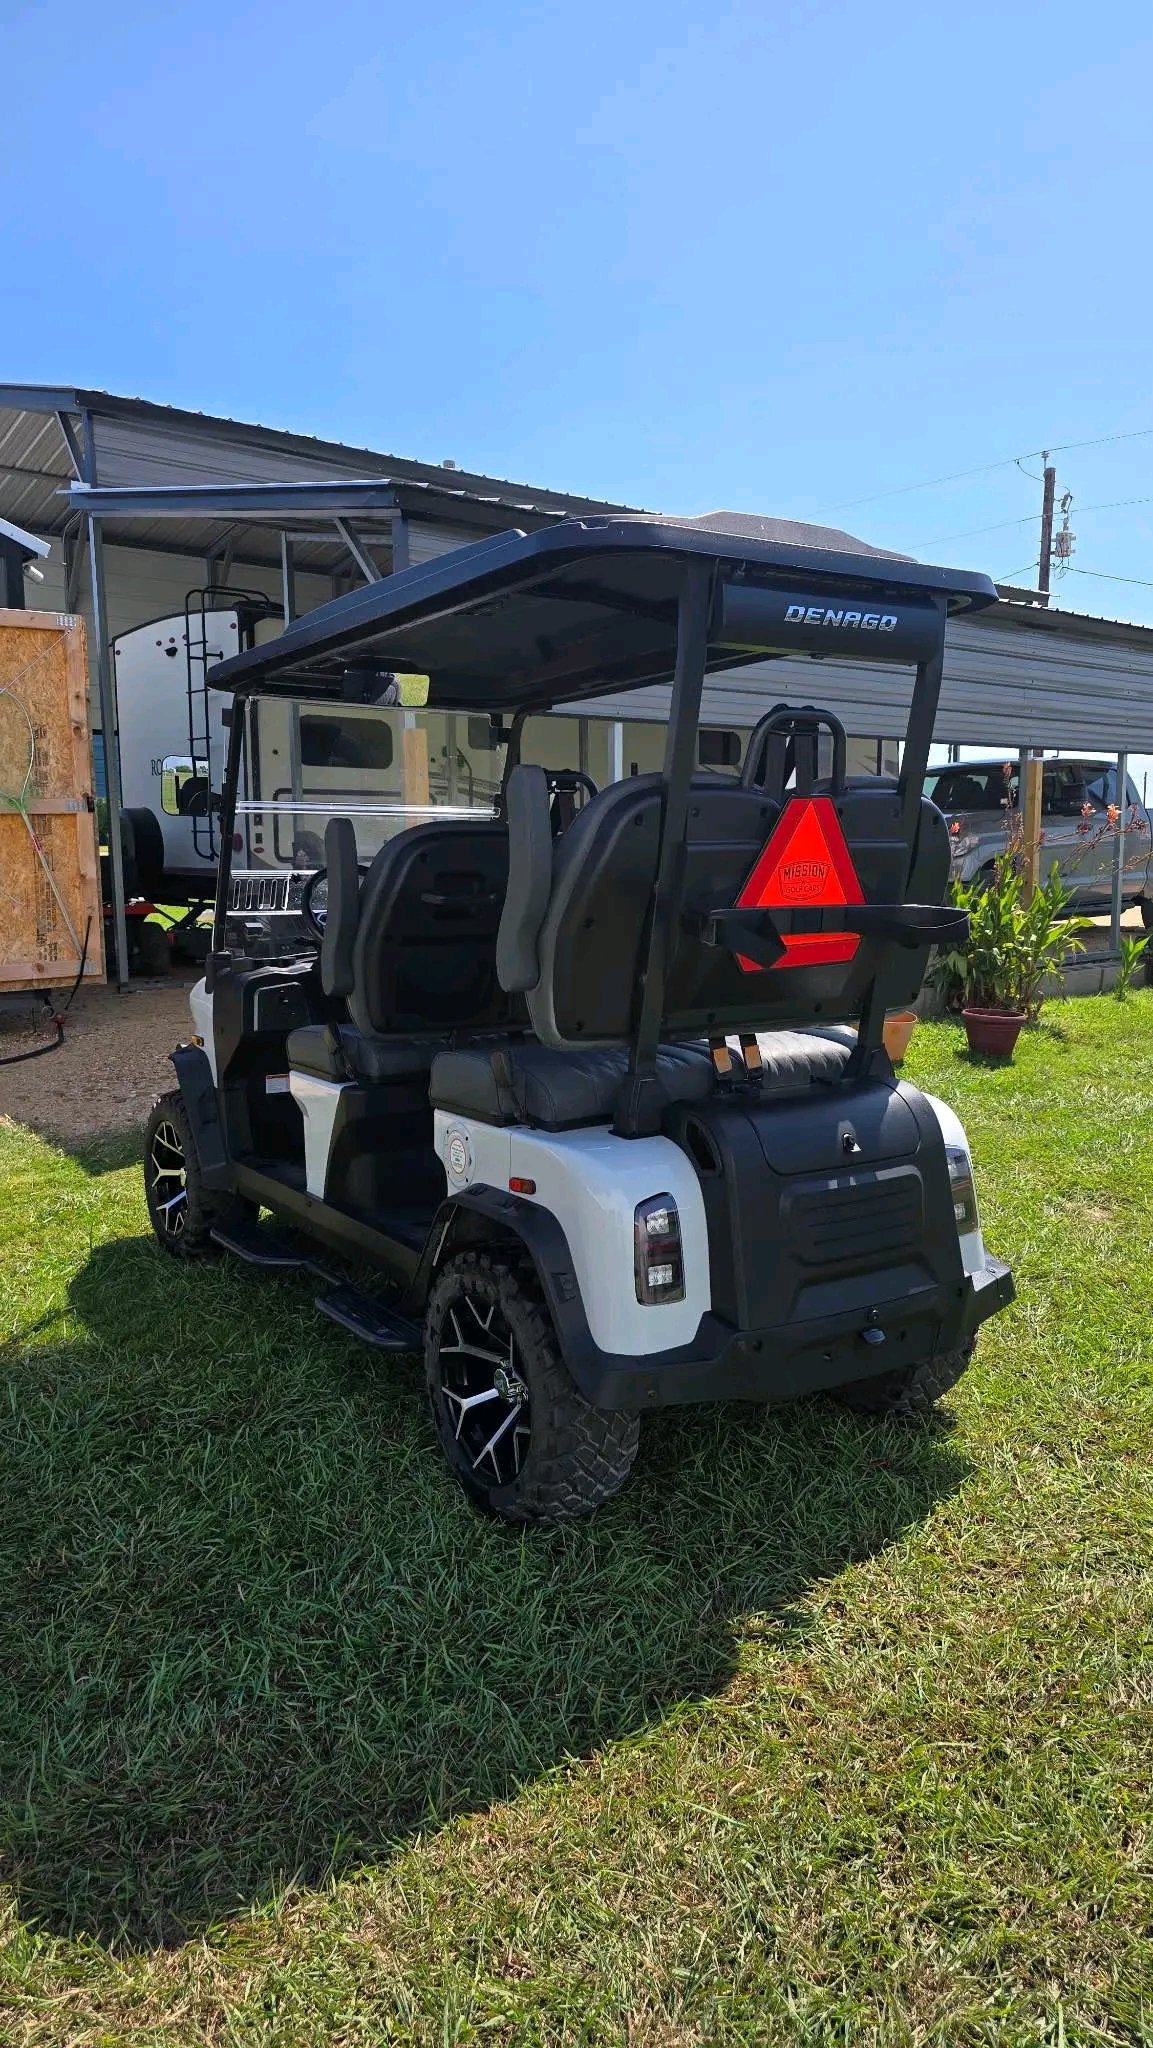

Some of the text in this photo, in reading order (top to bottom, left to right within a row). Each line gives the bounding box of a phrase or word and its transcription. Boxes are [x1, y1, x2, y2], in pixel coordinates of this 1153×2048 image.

[783, 605, 898, 631] DENAGO
[783, 864, 825, 880] MISSION
[785, 886, 803, 894] GOLF
